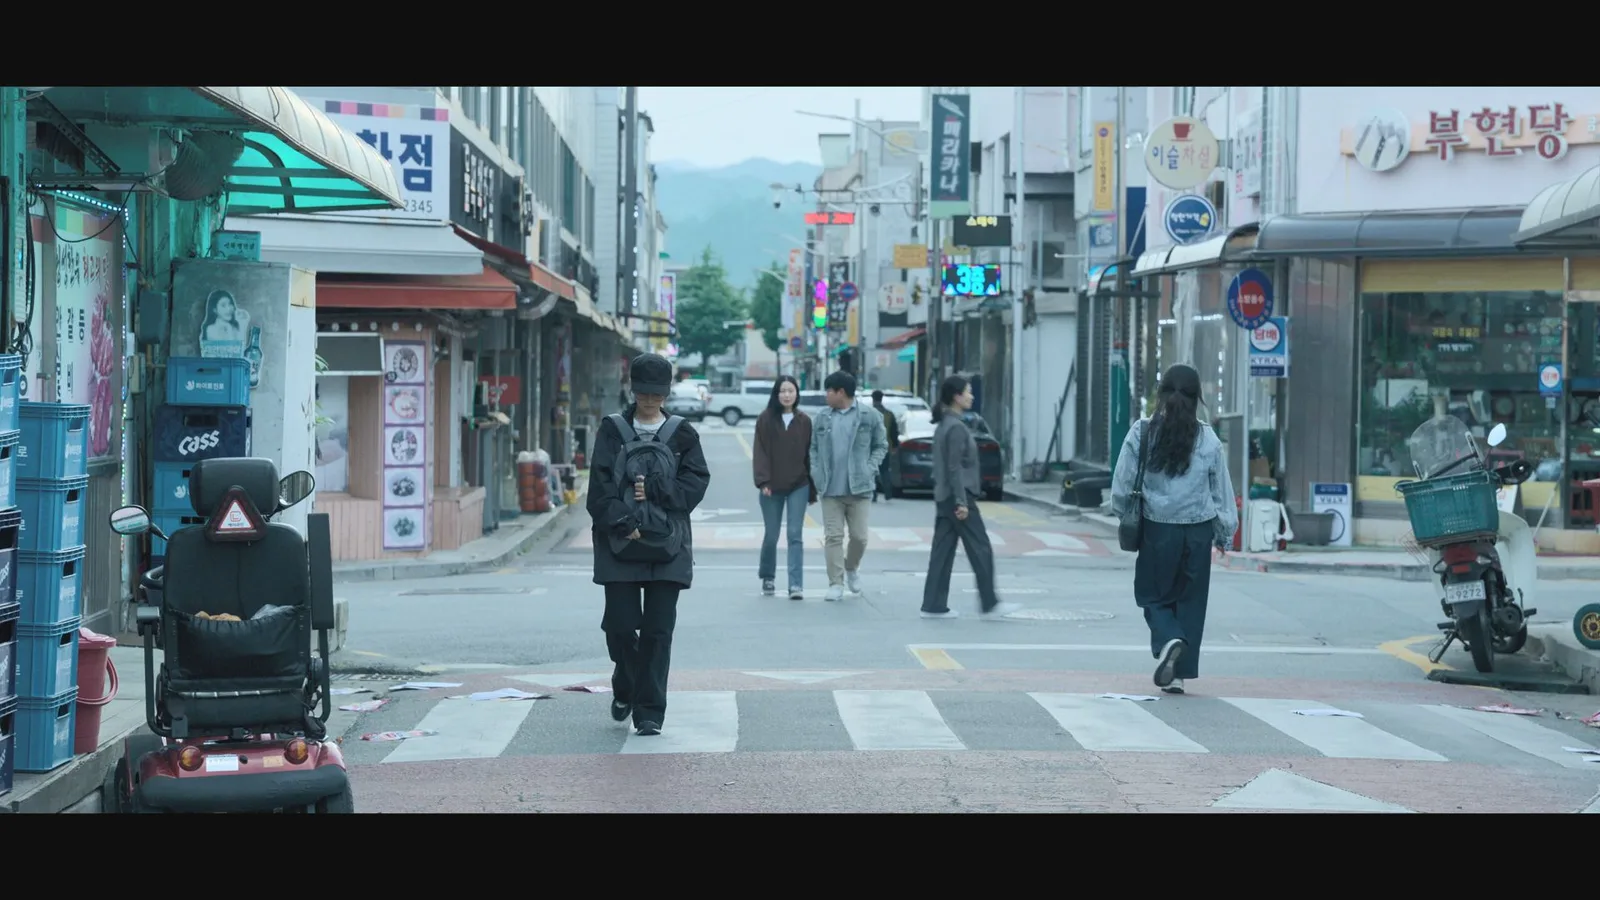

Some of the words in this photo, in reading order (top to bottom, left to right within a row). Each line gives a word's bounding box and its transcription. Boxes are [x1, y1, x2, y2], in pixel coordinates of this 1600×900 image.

[1425, 101, 1572, 161] 부현당
[957, 265, 985, 294] 3층
[1254, 328, 1277, 341] 담배
[1456, 588, 1482, 600] 9272
